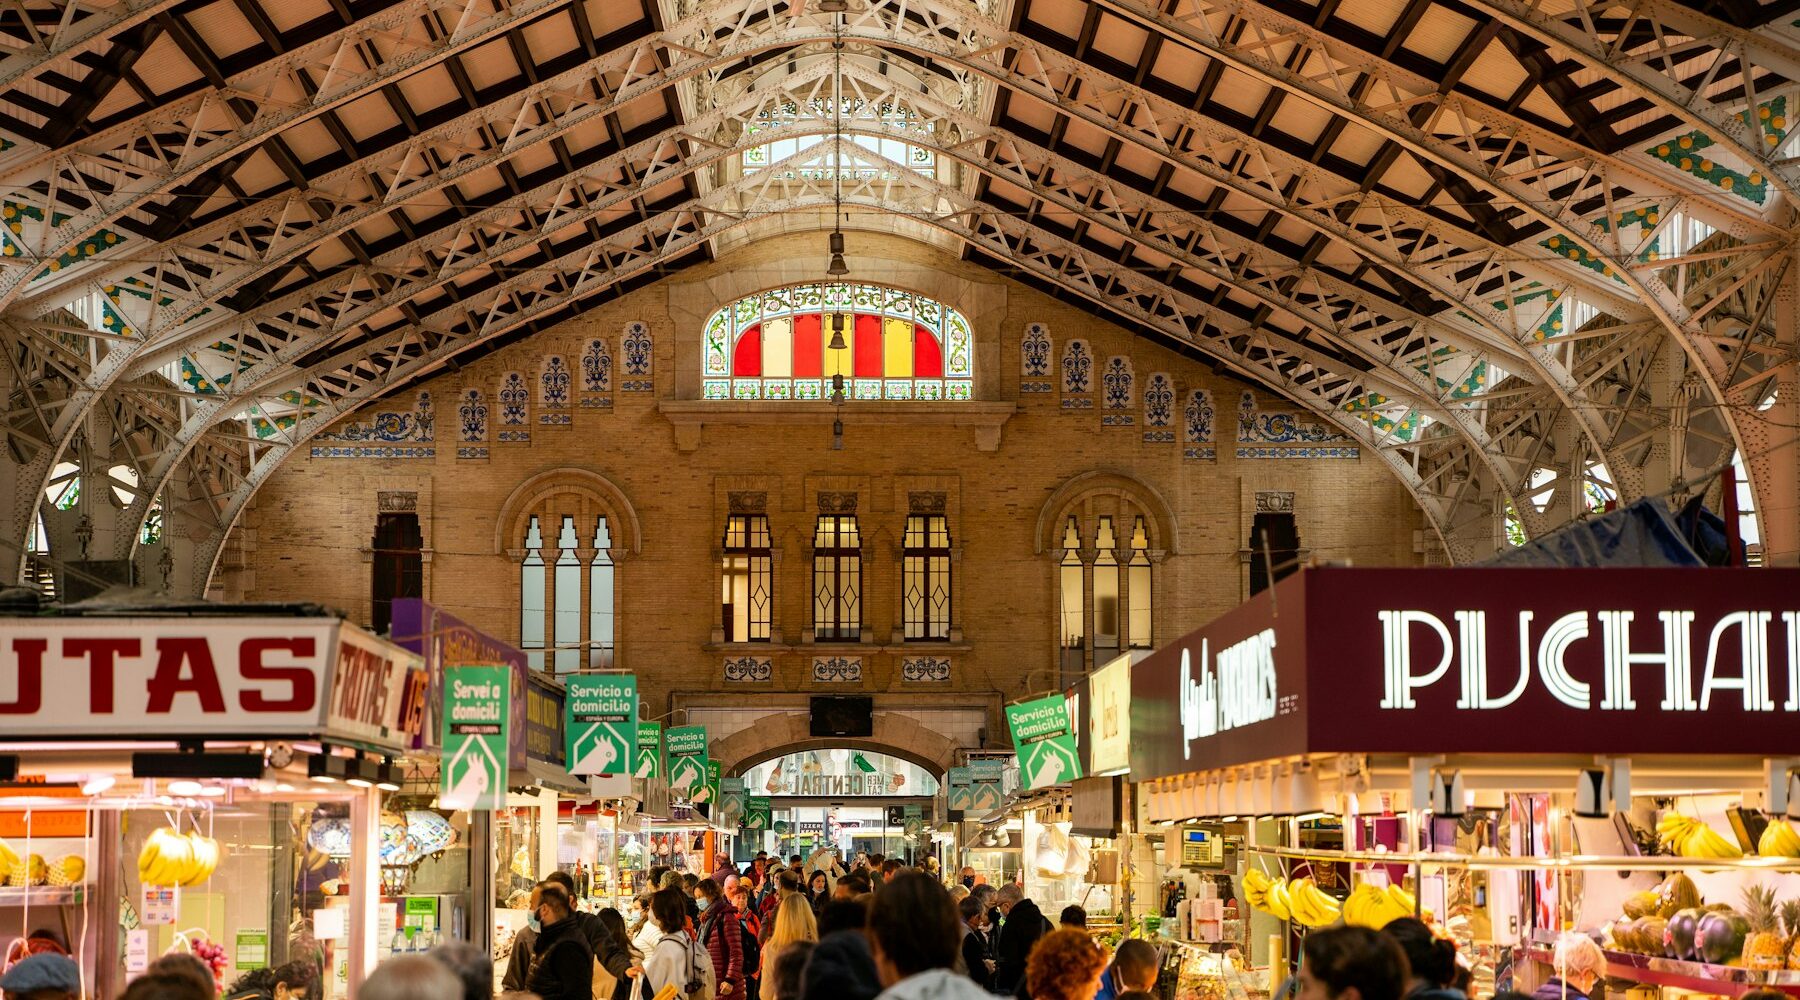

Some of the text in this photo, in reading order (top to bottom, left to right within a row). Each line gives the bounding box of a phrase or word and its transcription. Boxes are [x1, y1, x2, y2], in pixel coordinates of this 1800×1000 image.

[1378, 610, 1800, 711] PUCHA
[331, 641, 393, 727] FRUTAS
[453, 680, 501, 699] Servei a
[571, 684, 632, 697] Servicio a
[452, 701, 500, 720] domicili
[572, 699, 631, 712] domicilio
[1011, 705, 1064, 725] Servicio a
[1016, 716, 1066, 737] domicilio
[667, 733, 697, 743] Servicio
[668, 741, 704, 752] domicilio
